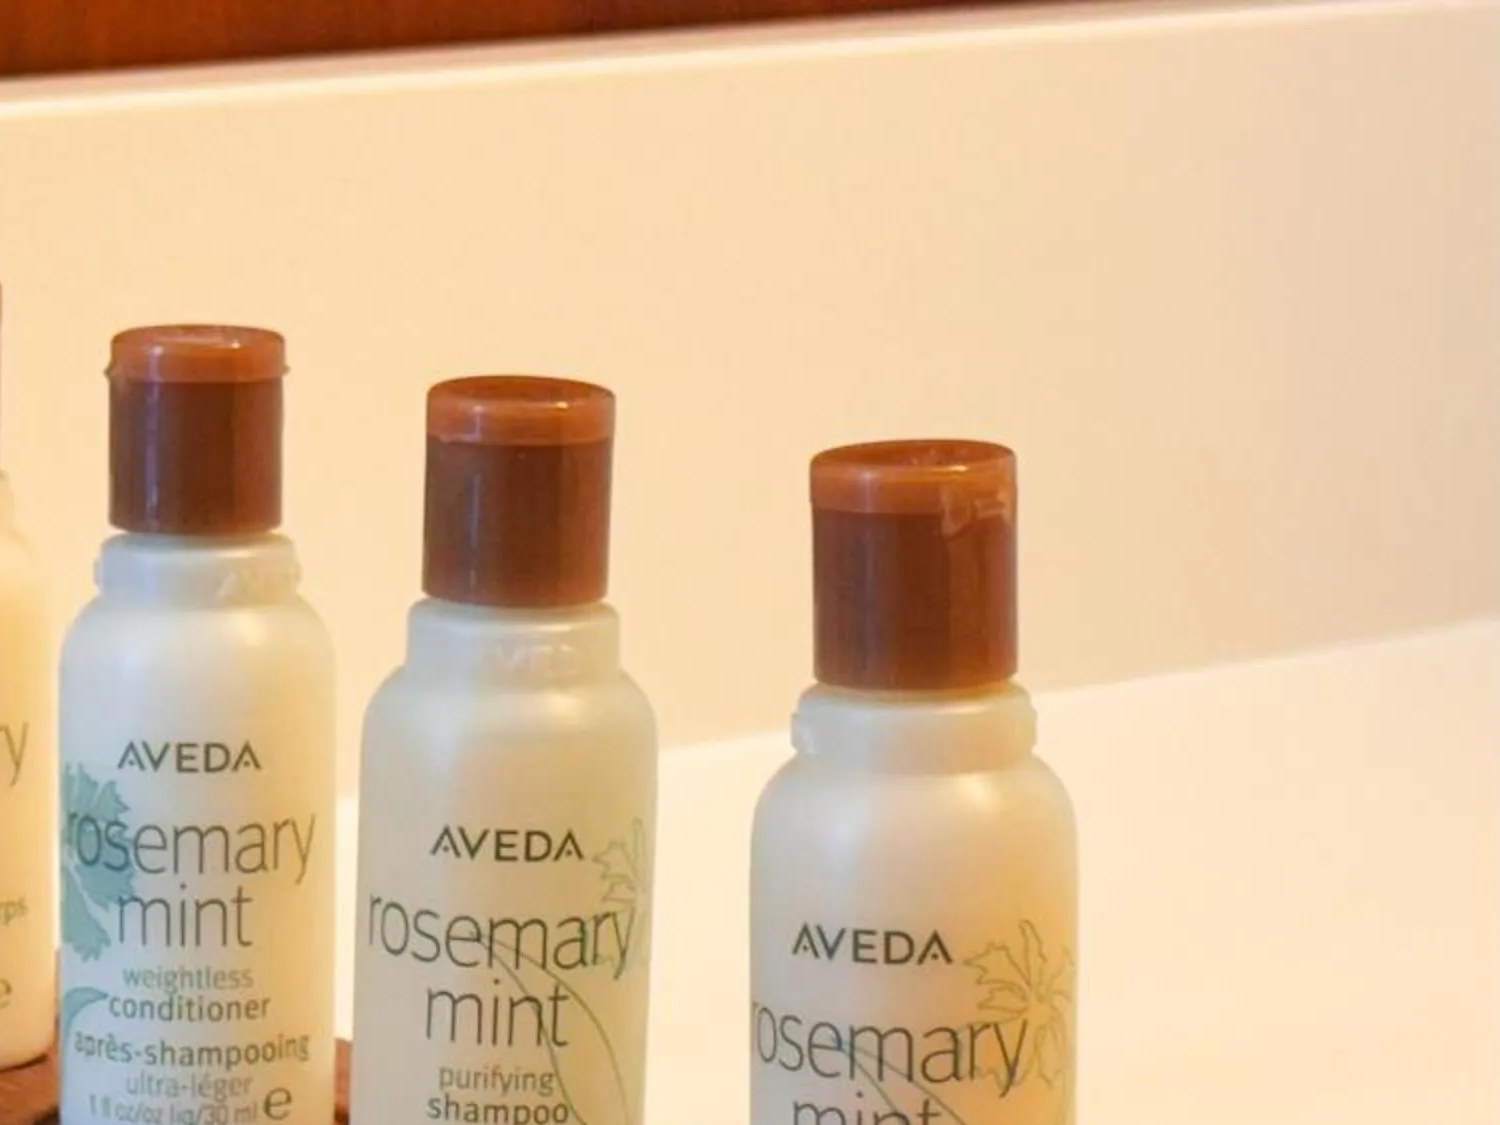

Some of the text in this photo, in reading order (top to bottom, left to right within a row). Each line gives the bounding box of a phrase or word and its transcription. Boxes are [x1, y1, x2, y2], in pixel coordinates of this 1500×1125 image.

[117, 741, 262, 773] AVEDA
[67, 810, 316, 885] rosemary
[431, 825, 584, 863] AVEDA
[118, 883, 253, 947] mint
[368, 893, 636, 981] rosemary
[792, 922, 953, 965] AVEDA
[123, 965, 254, 995] weightless
[109, 995, 271, 1023] conditioner
[426, 977, 570, 1047] mint
[74, 1031, 310, 1072] après-shampooing
[127, 1070, 253, 1103] ultra-léger
[439, 1065, 555, 1098] purifying
